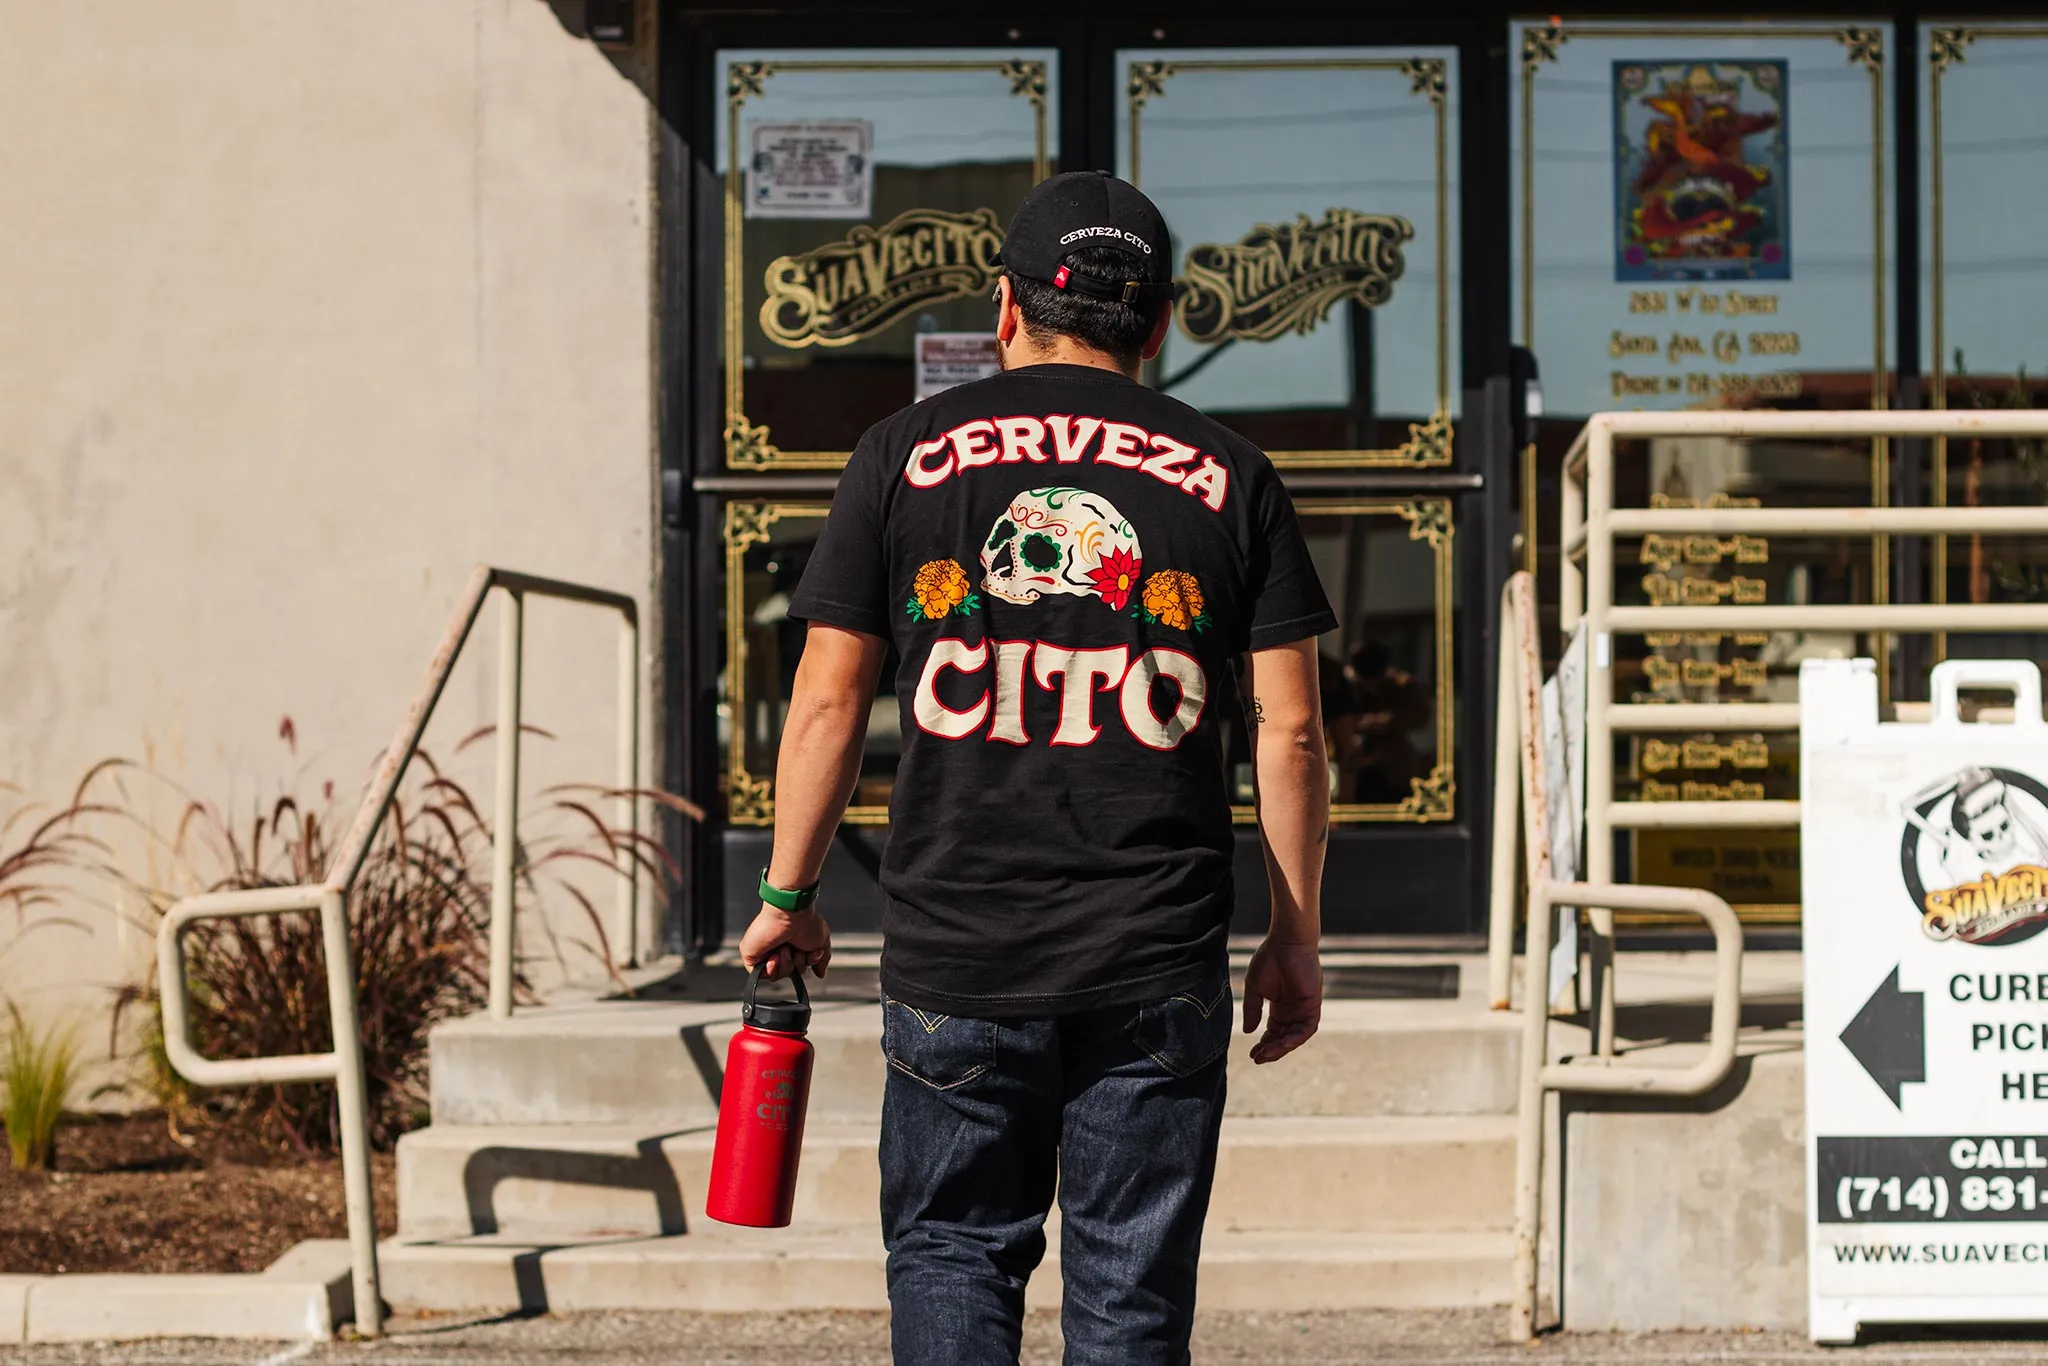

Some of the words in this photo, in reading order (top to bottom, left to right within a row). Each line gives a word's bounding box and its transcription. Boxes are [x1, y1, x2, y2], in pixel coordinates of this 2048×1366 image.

[1060, 226, 1122, 245] CERVEZA
[1123, 232, 1152, 254] CITO
[904, 414, 1229, 512] CERVEZA
[913, 637, 1207, 750] CITO
[1972, 1022, 2048, 1050] PIC
[757, 1103, 798, 1120] CIT
[1949, 1138, 2047, 1170] CALL
[1836, 1177, 1949, 1218] (714)
